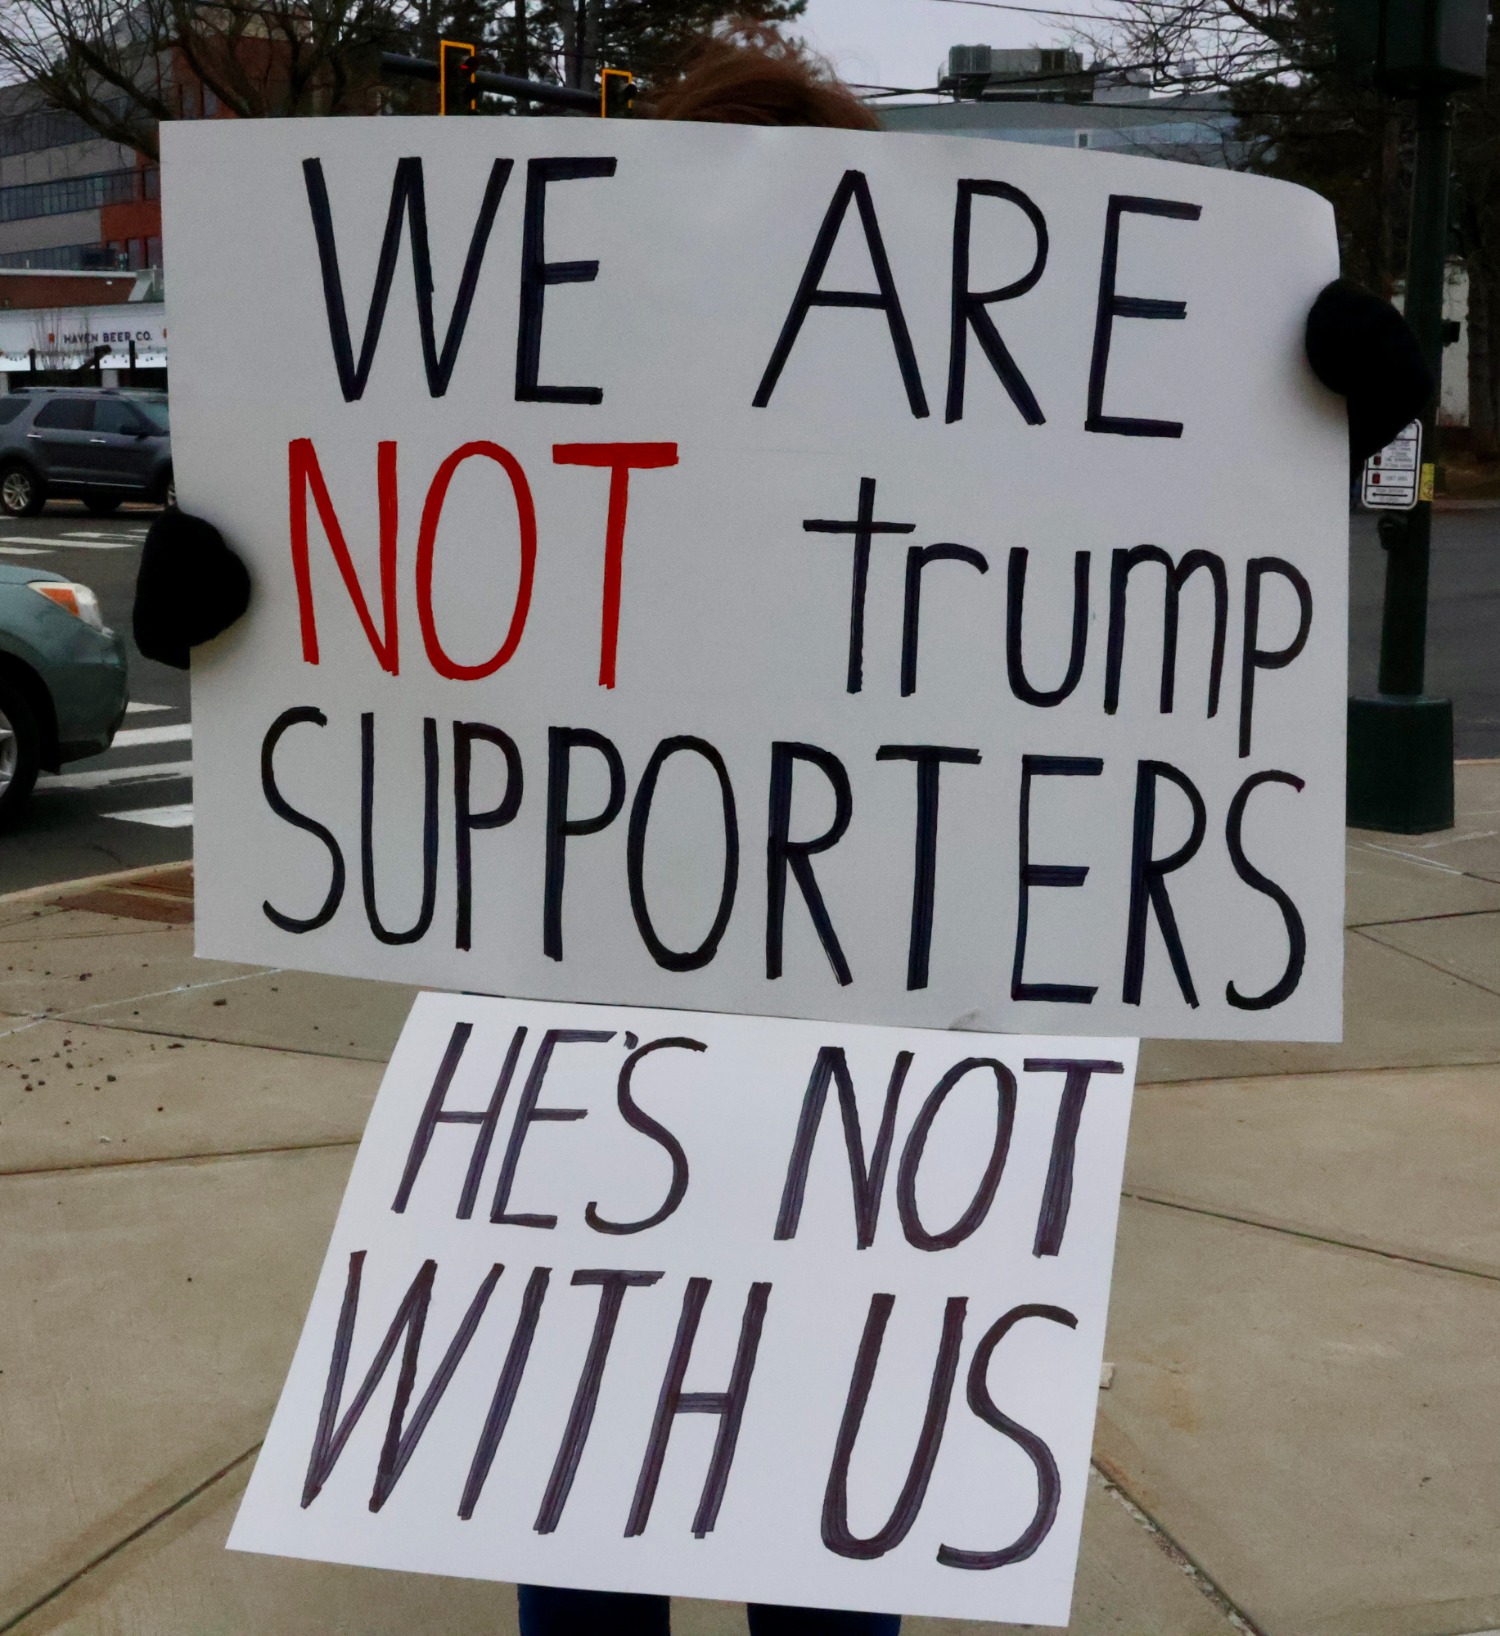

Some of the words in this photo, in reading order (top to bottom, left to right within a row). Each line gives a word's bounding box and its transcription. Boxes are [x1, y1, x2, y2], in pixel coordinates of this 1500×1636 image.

[64, 333, 98, 344] HAVEN
[103, 331, 131, 343] BEER
[135, 331, 152, 341] CO.
[302, 157, 618, 405] WE
[752, 169, 1203, 438] ARE
[288, 438, 679, 690] NOT
[803, 478, 1312, 759] trump
[261, 705, 1306, 1012] SUPPORTERS
[391, 1021, 707, 1235] HE'S
[774, 1046, 1126, 1258] NOT
[301, 1251, 774, 1539] WITH
[821, 1293, 1078, 1570] US
